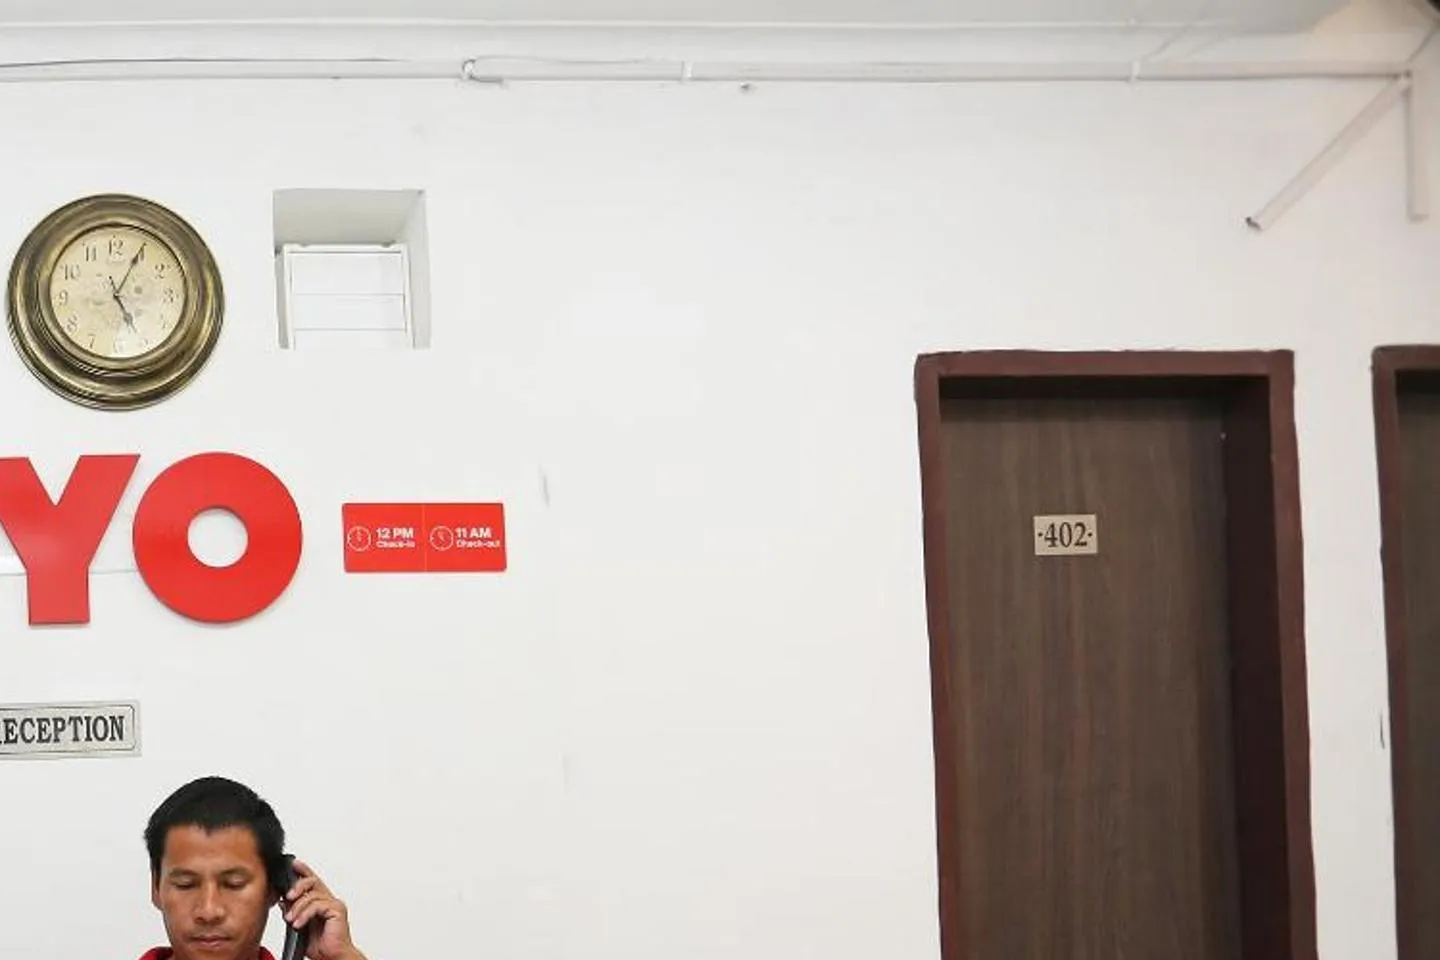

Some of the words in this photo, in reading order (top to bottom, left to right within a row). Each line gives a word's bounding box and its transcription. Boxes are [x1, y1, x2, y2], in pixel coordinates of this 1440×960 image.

[85, 245, 97, 262] 11
[109, 239, 124, 256] 12
[63, 263, 80, 280] 10
[154, 263, 165, 281] 2
[59, 289, 68, 306] 9
[376, 527, 391, 539] 12
[393, 527, 414, 539] PM
[456, 527, 468, 539] 11
[470, 527, 492, 539] AM
[456, 539, 500, 549] Check-out
